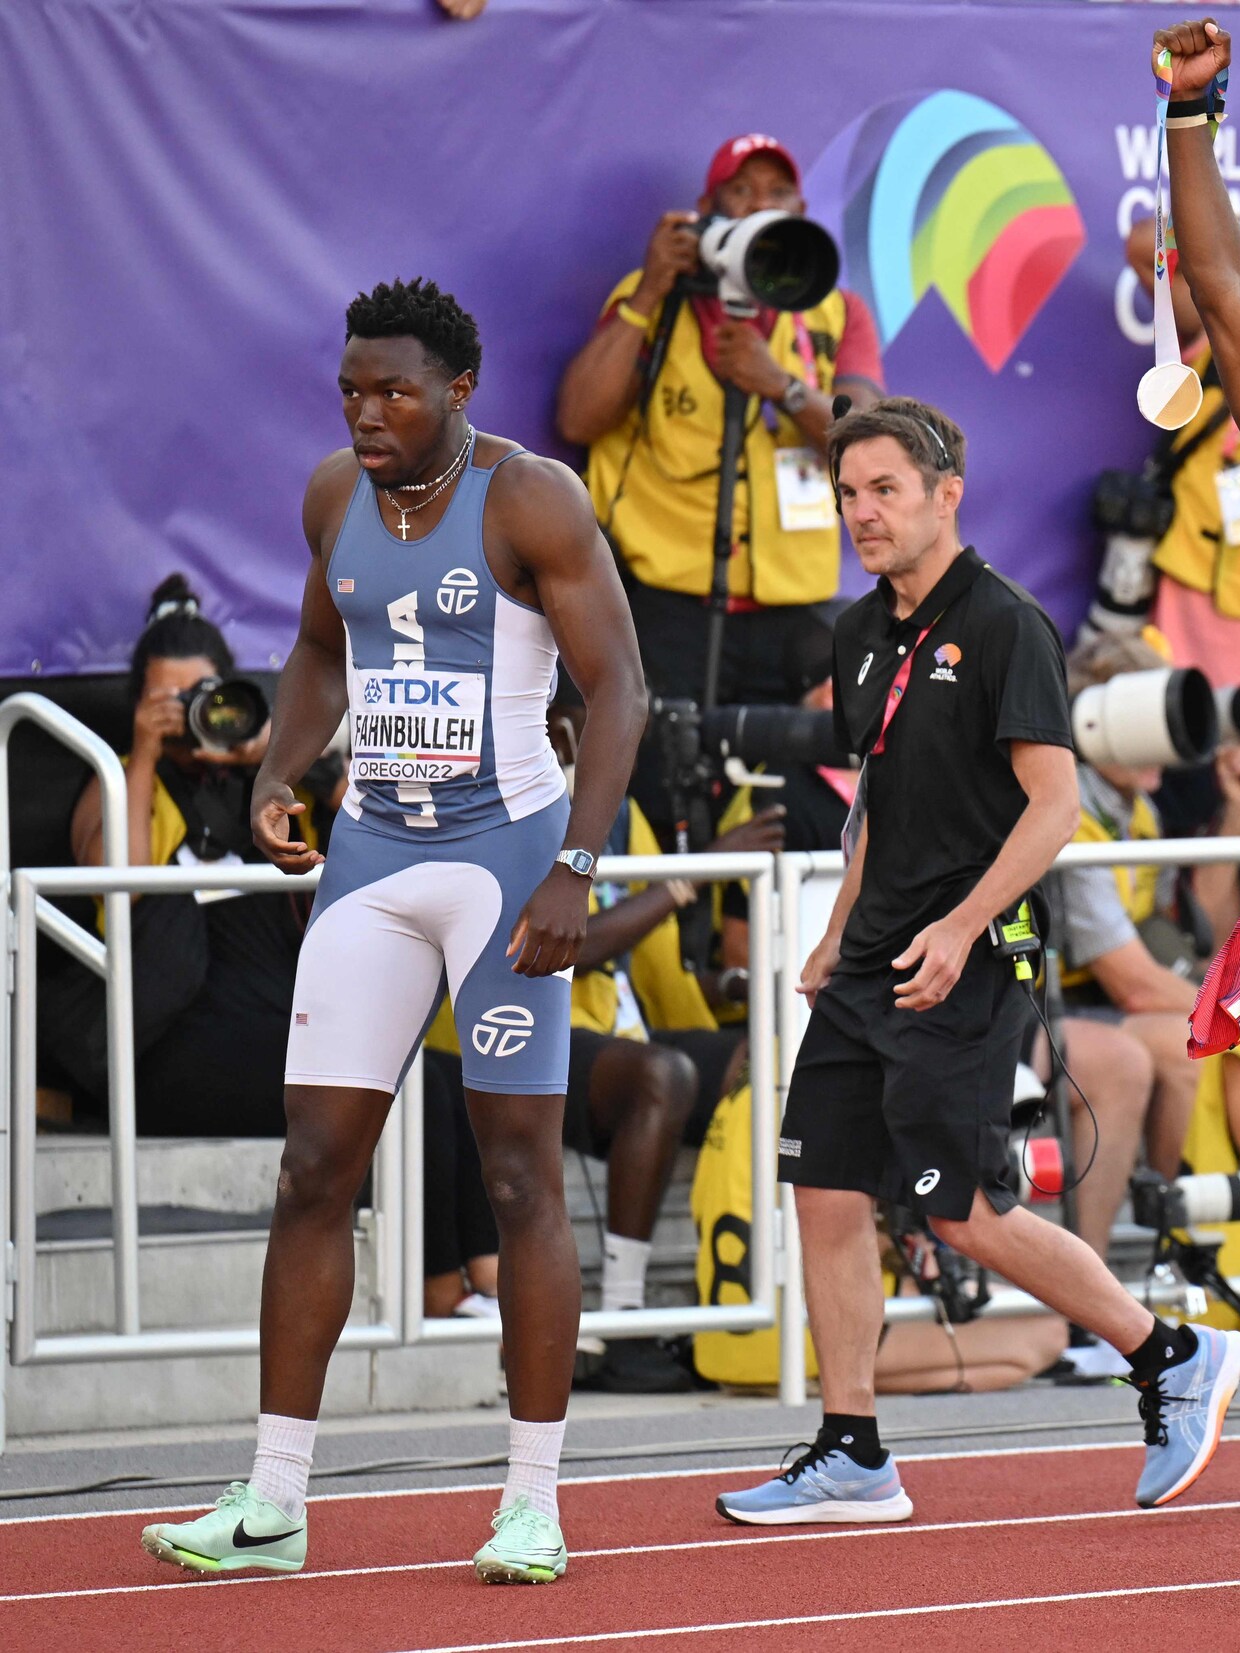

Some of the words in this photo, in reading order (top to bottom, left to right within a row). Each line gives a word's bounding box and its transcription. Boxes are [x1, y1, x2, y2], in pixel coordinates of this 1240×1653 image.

[381, 678, 461, 707] TDK
[354, 713, 476, 751] FAHNBULLEH
[358, 761, 454, 780] OREGON22
